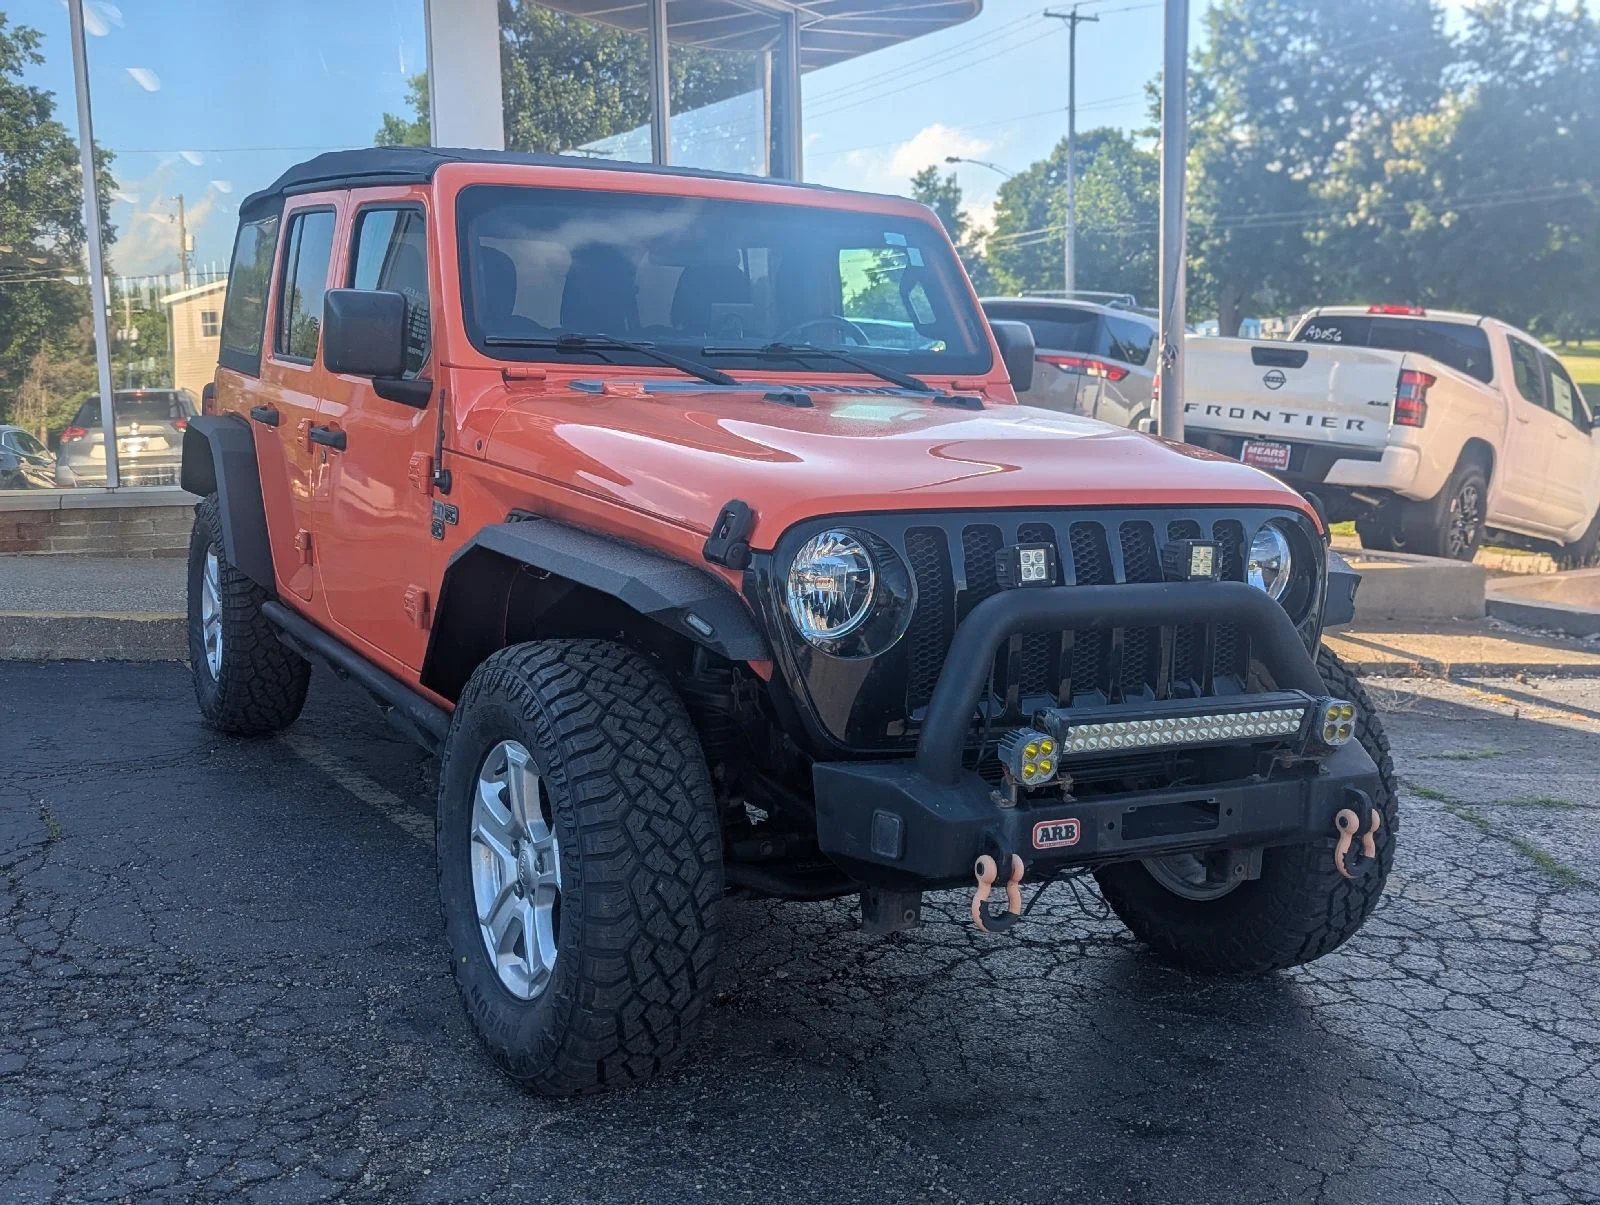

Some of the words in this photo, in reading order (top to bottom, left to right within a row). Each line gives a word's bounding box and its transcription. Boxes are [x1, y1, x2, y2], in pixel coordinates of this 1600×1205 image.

[1184, 402, 1366, 431] FRONTIER
[1247, 446, 1287, 458] MEARS
[1039, 824, 1076, 842] ARB
